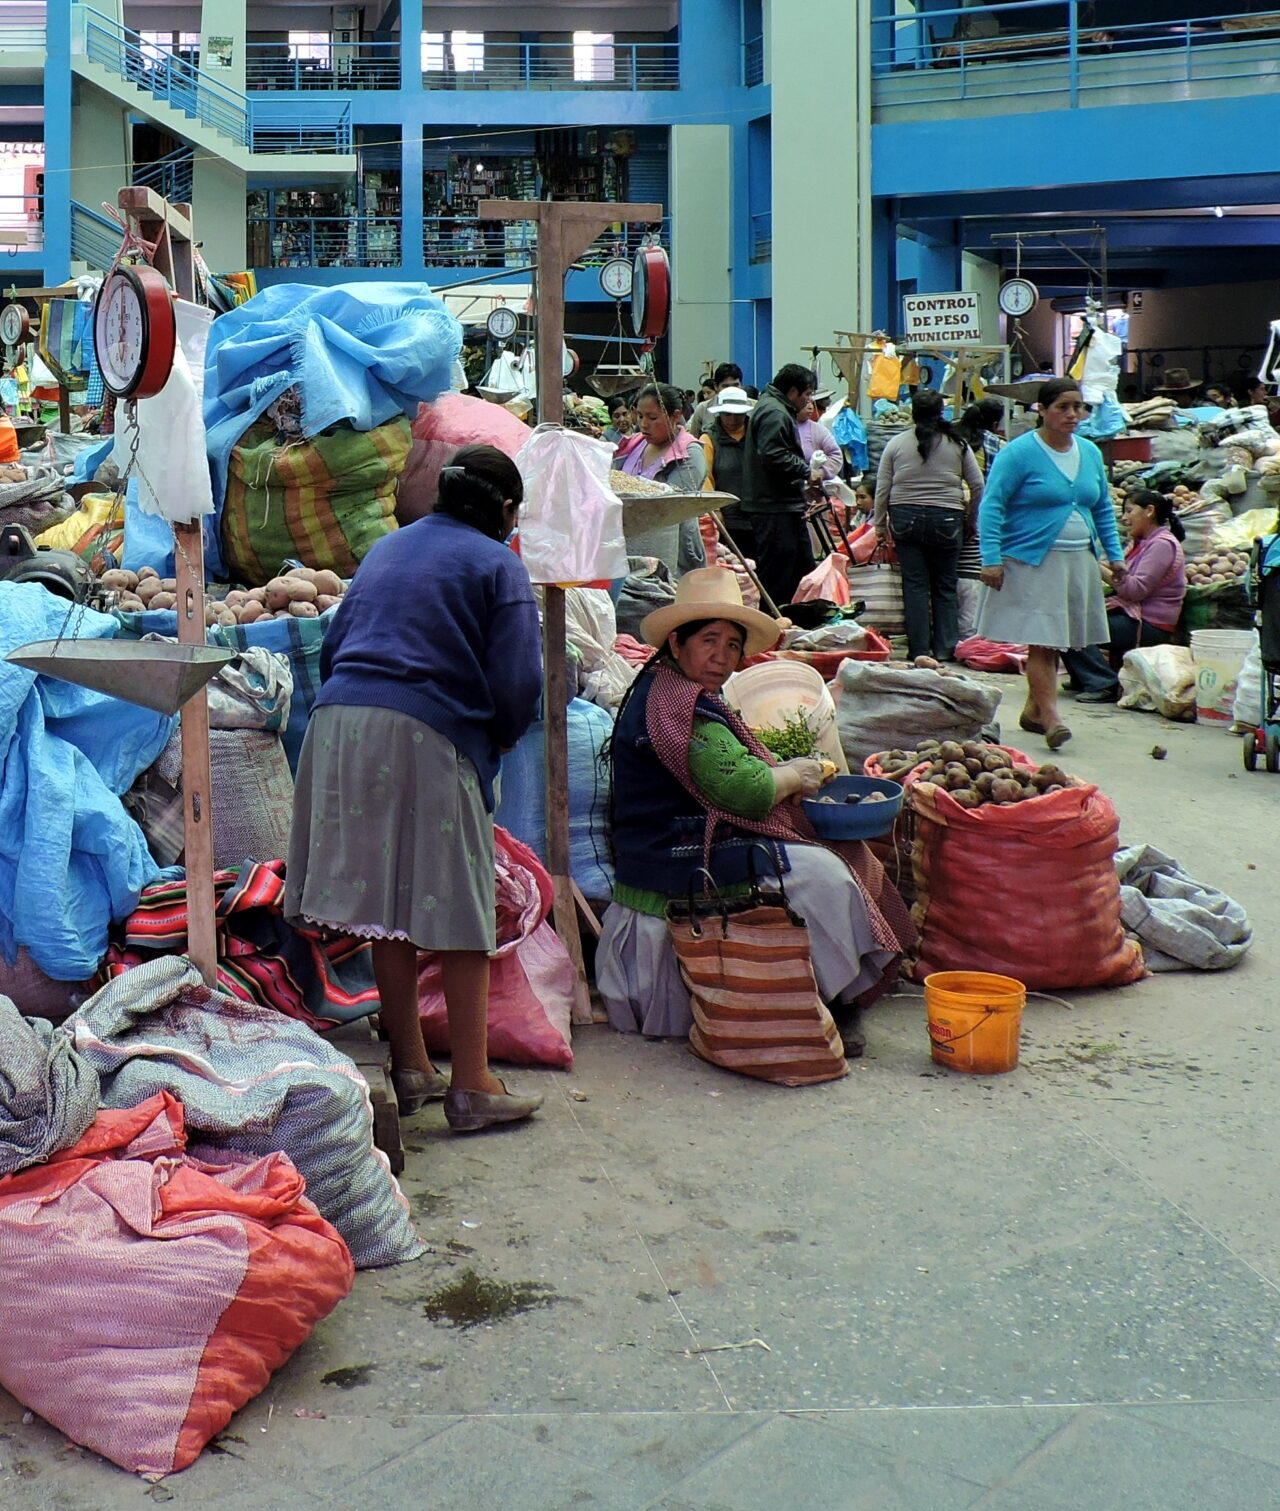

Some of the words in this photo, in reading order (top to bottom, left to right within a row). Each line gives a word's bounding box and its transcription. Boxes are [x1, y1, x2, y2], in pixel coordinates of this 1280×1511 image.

[907, 298, 976, 311] CONTROL
[913, 316, 931, 327] DE
[934, 314, 970, 326] PESO
[906, 329, 981, 342] MUNICIPAL
